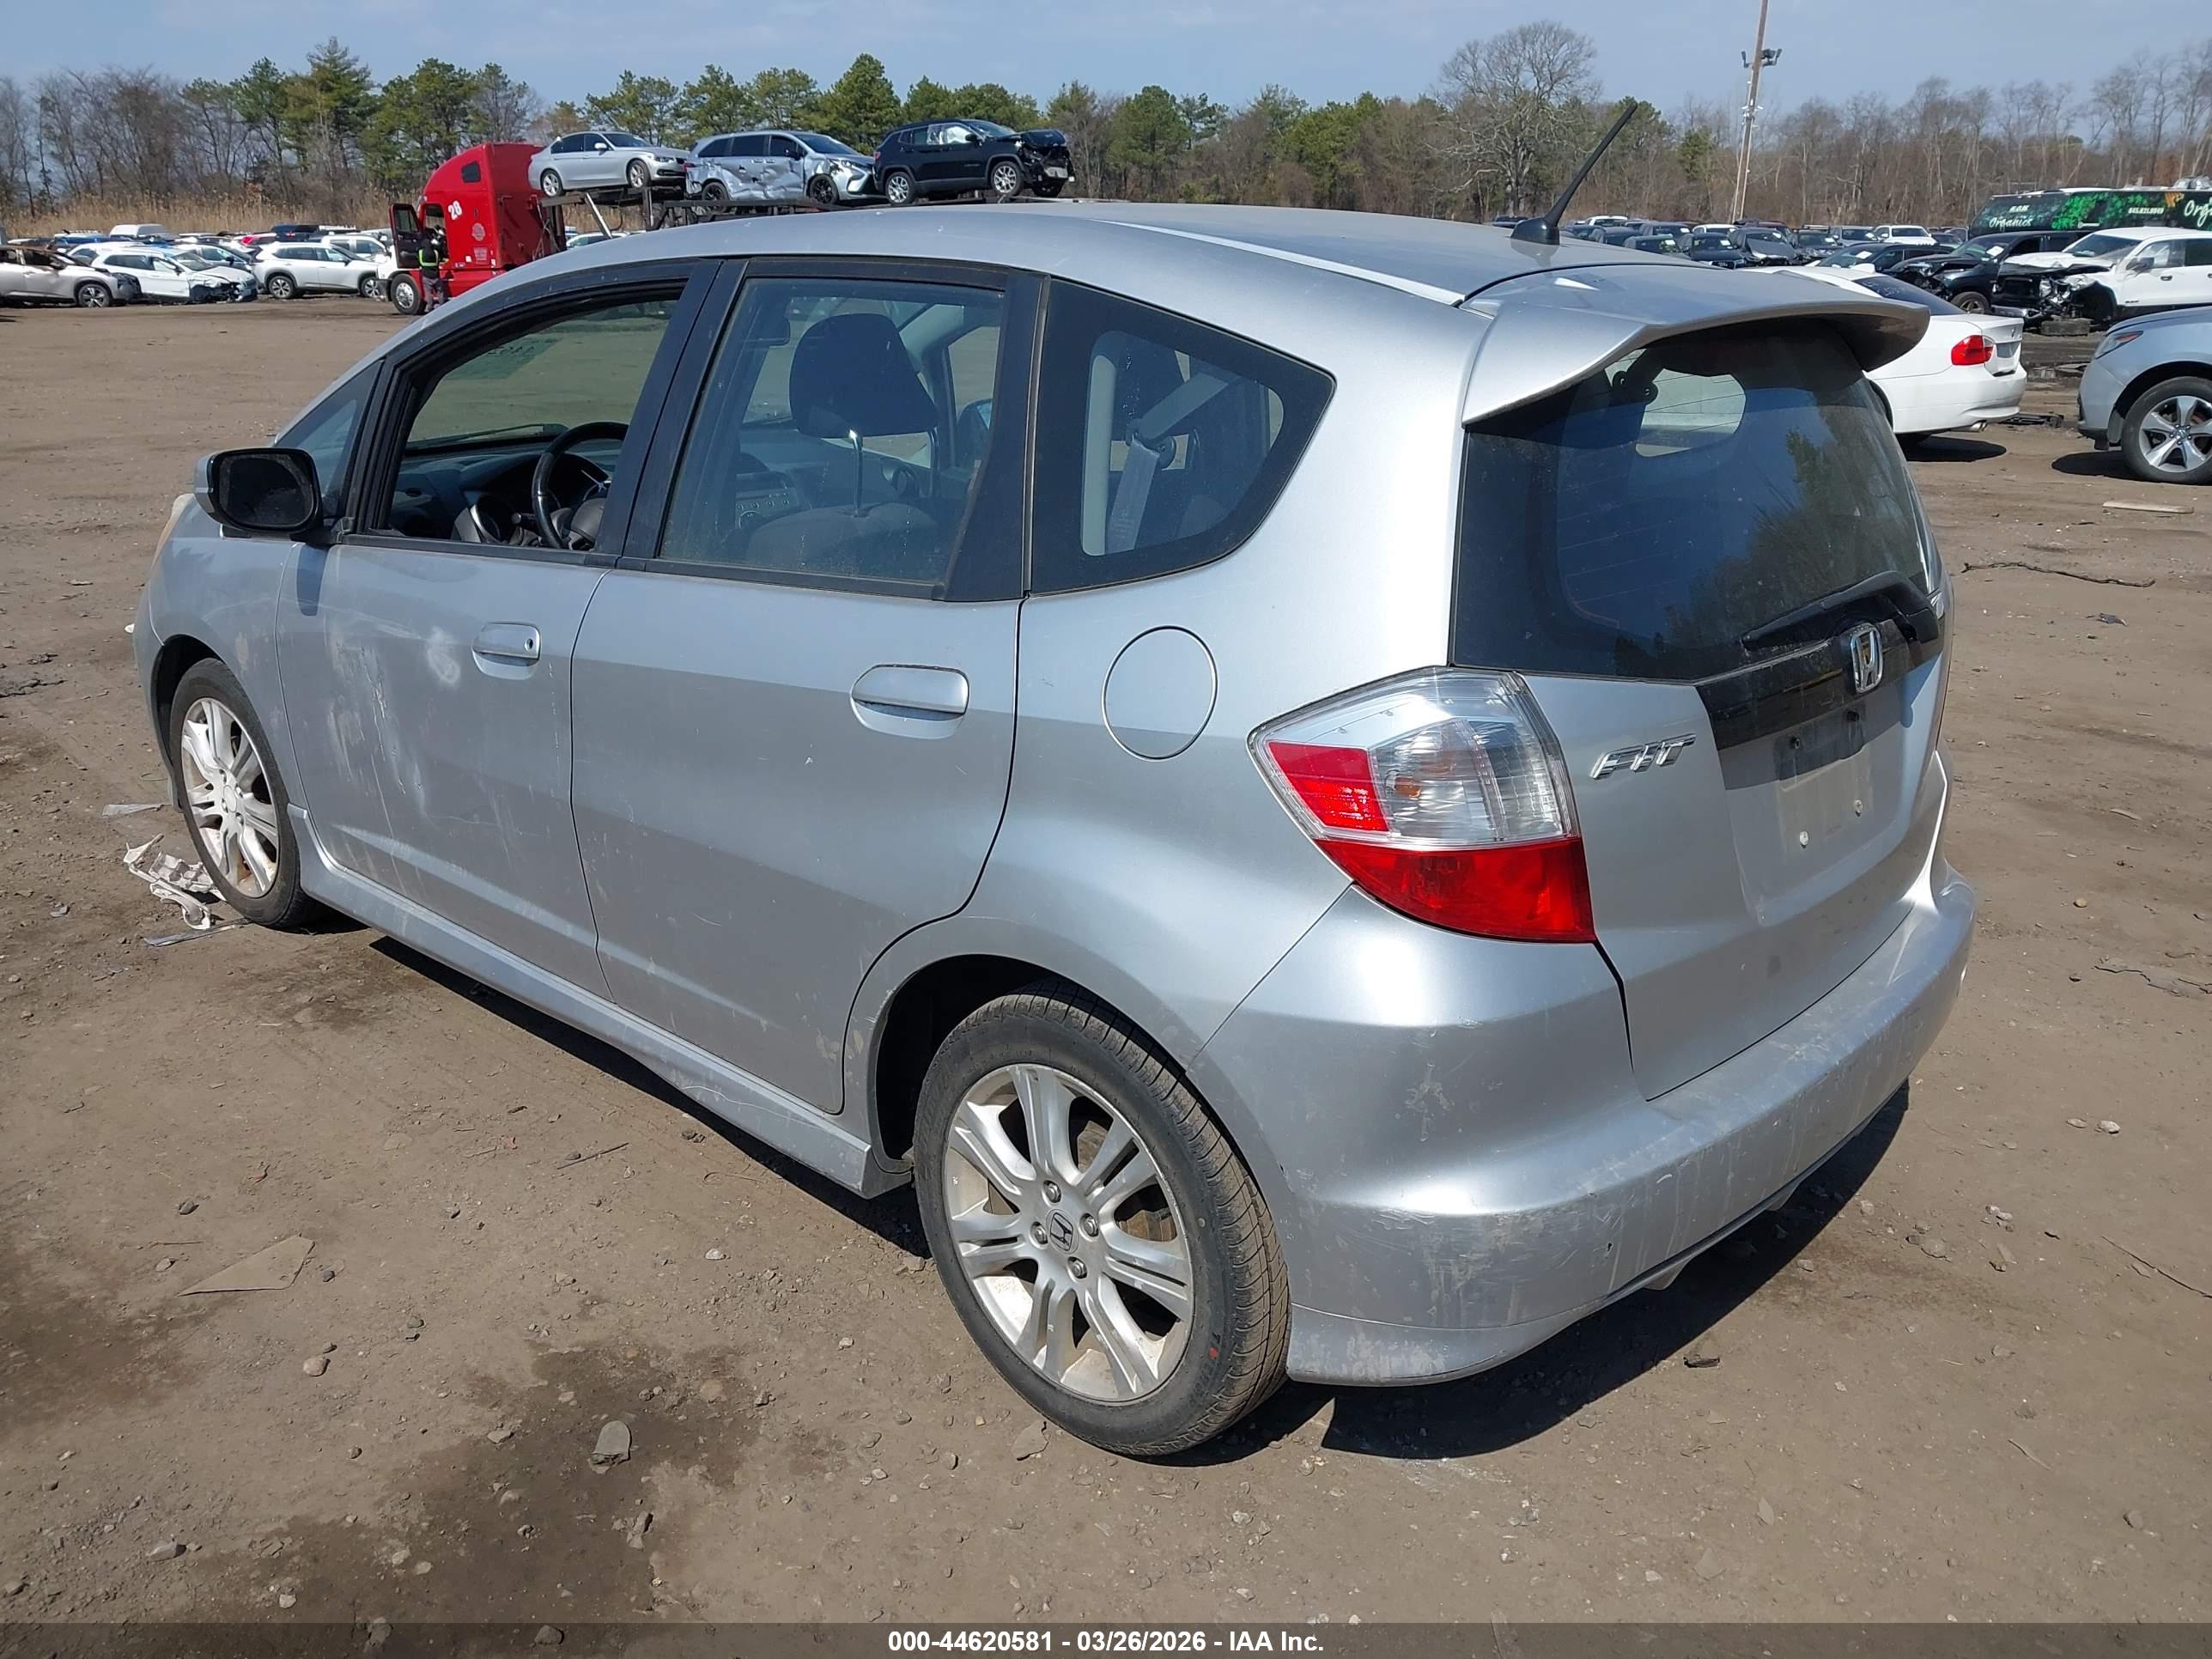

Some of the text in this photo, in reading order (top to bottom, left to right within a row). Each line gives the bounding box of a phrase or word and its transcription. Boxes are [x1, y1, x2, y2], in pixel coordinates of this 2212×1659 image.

[447, 199, 462, 220] 28
[2184, 199, 2212, 228] Org
[1989, 215, 2033, 232] Organics
[1589, 732, 1697, 779] FIT
